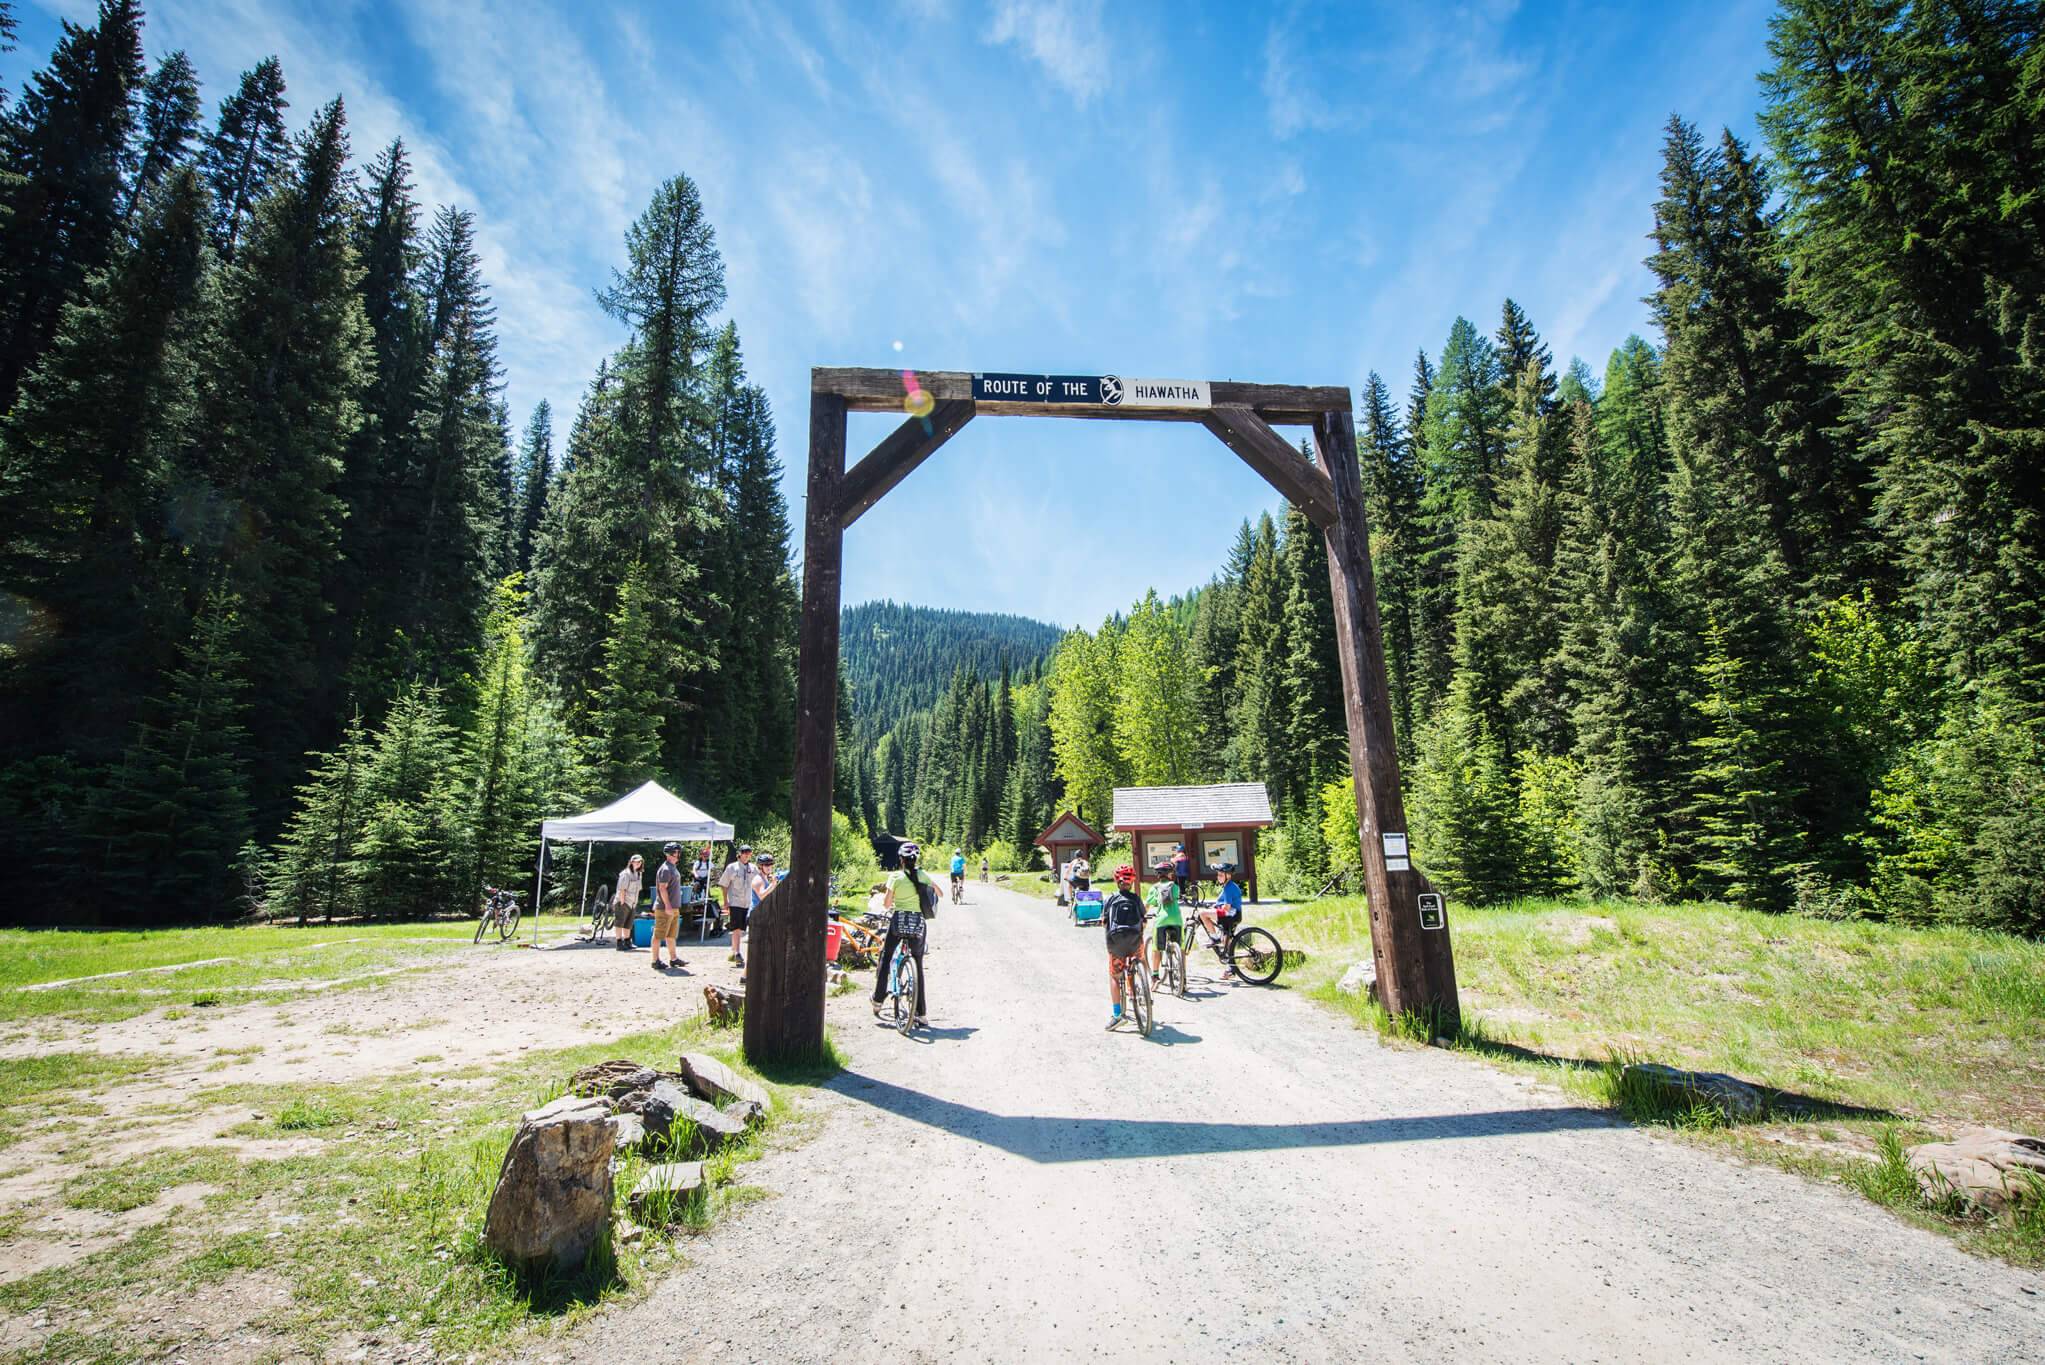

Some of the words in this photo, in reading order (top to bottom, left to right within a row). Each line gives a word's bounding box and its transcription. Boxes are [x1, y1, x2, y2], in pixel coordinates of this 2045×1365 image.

[983, 380, 1028, 394] ROUTE
[1036, 382, 1053, 395] OF
[1062, 382, 1088, 396] THE
[1135, 386, 1199, 400] HIAWATHA
